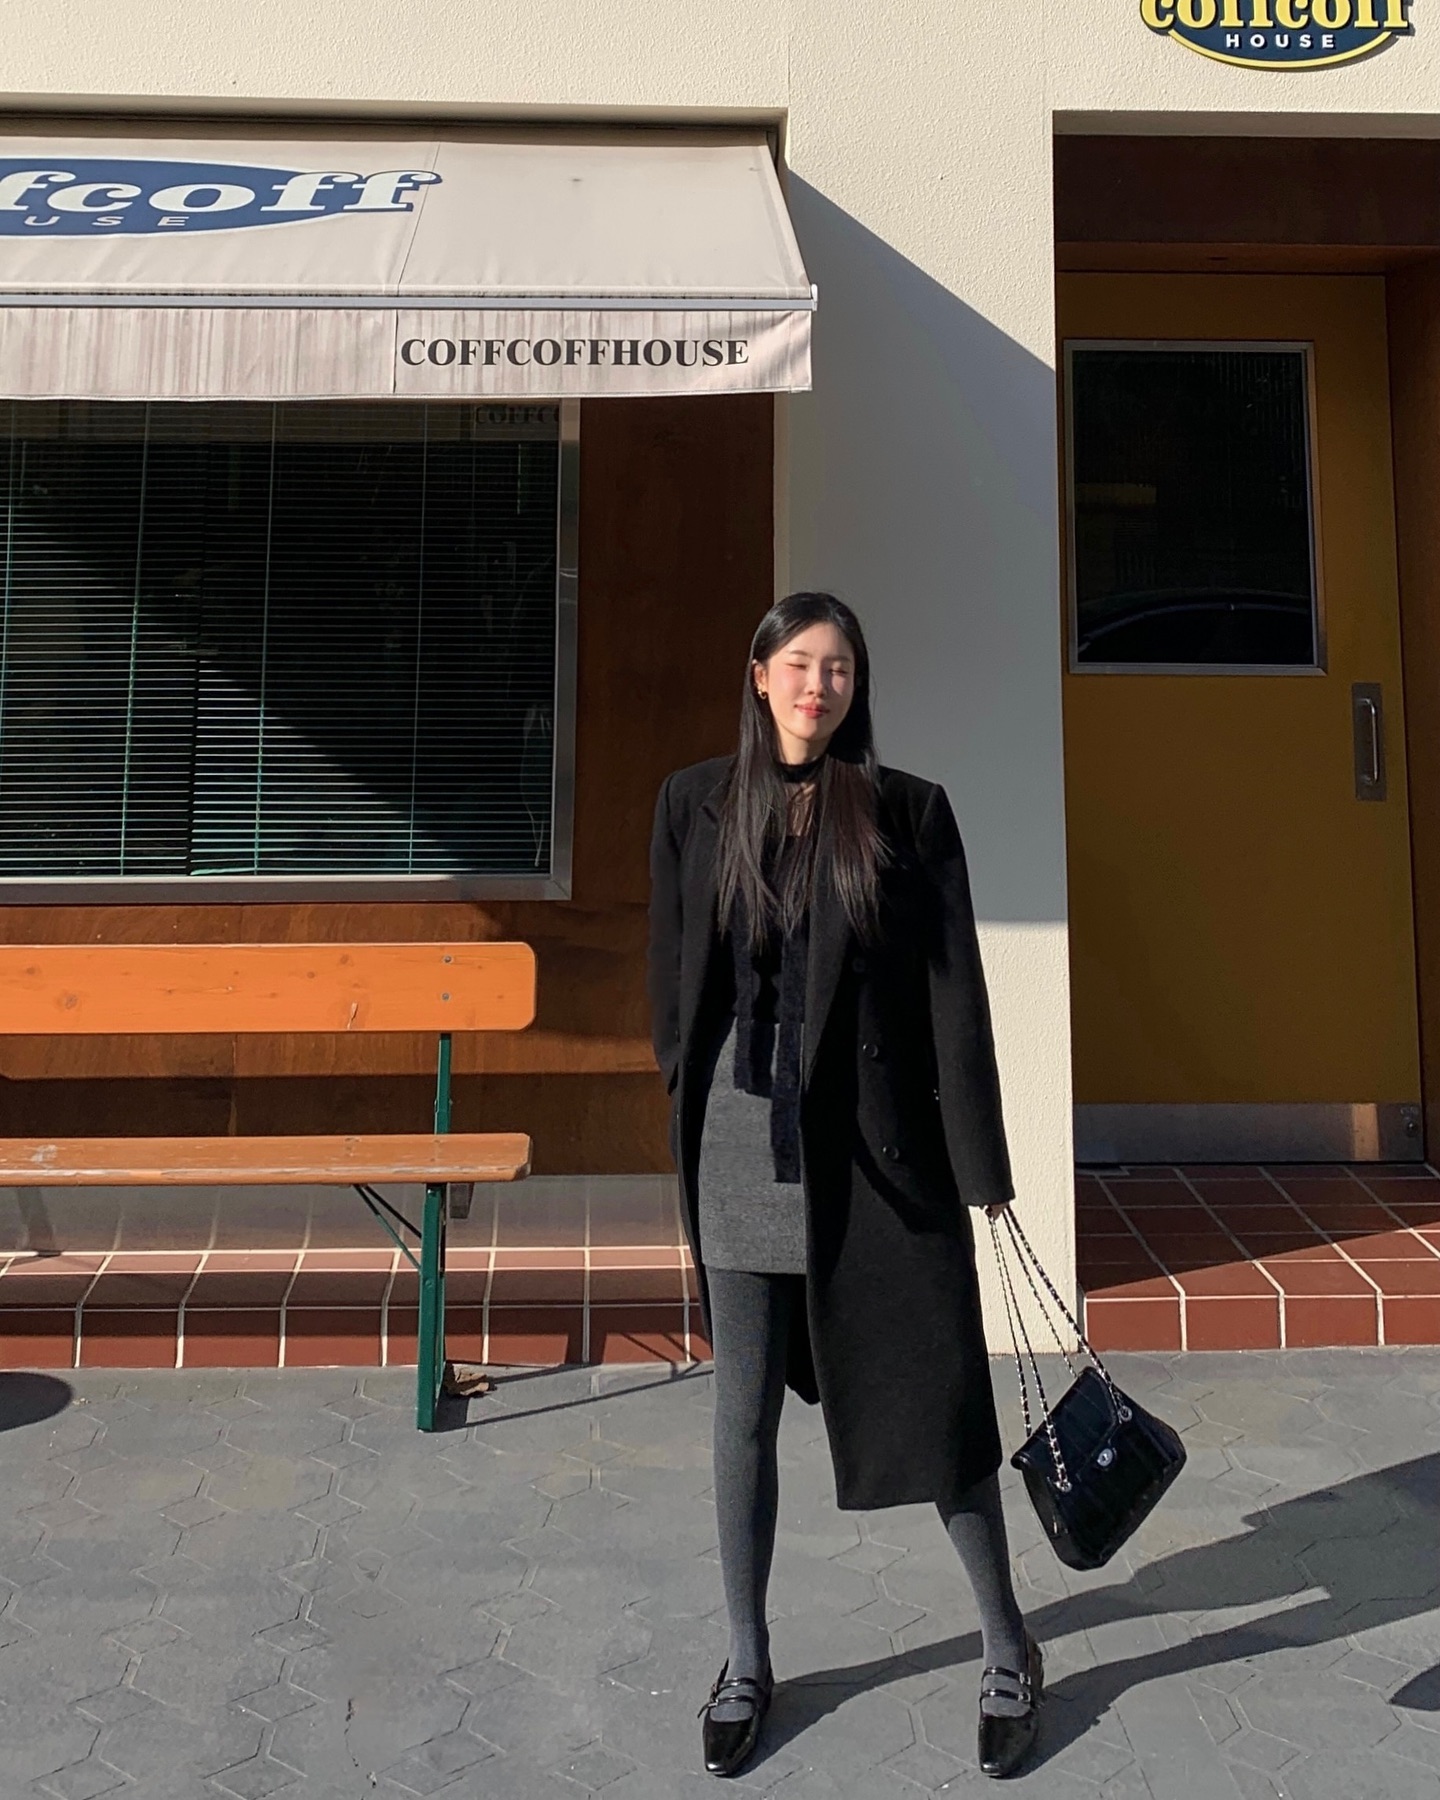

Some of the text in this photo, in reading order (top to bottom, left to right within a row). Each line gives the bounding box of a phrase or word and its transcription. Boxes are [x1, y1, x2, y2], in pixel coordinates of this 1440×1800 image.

[1225, 34, 1334, 48] HOUSE
[23, 215, 190, 227] USE
[401, 338, 749, 367] COFFCOFFHOUSE
